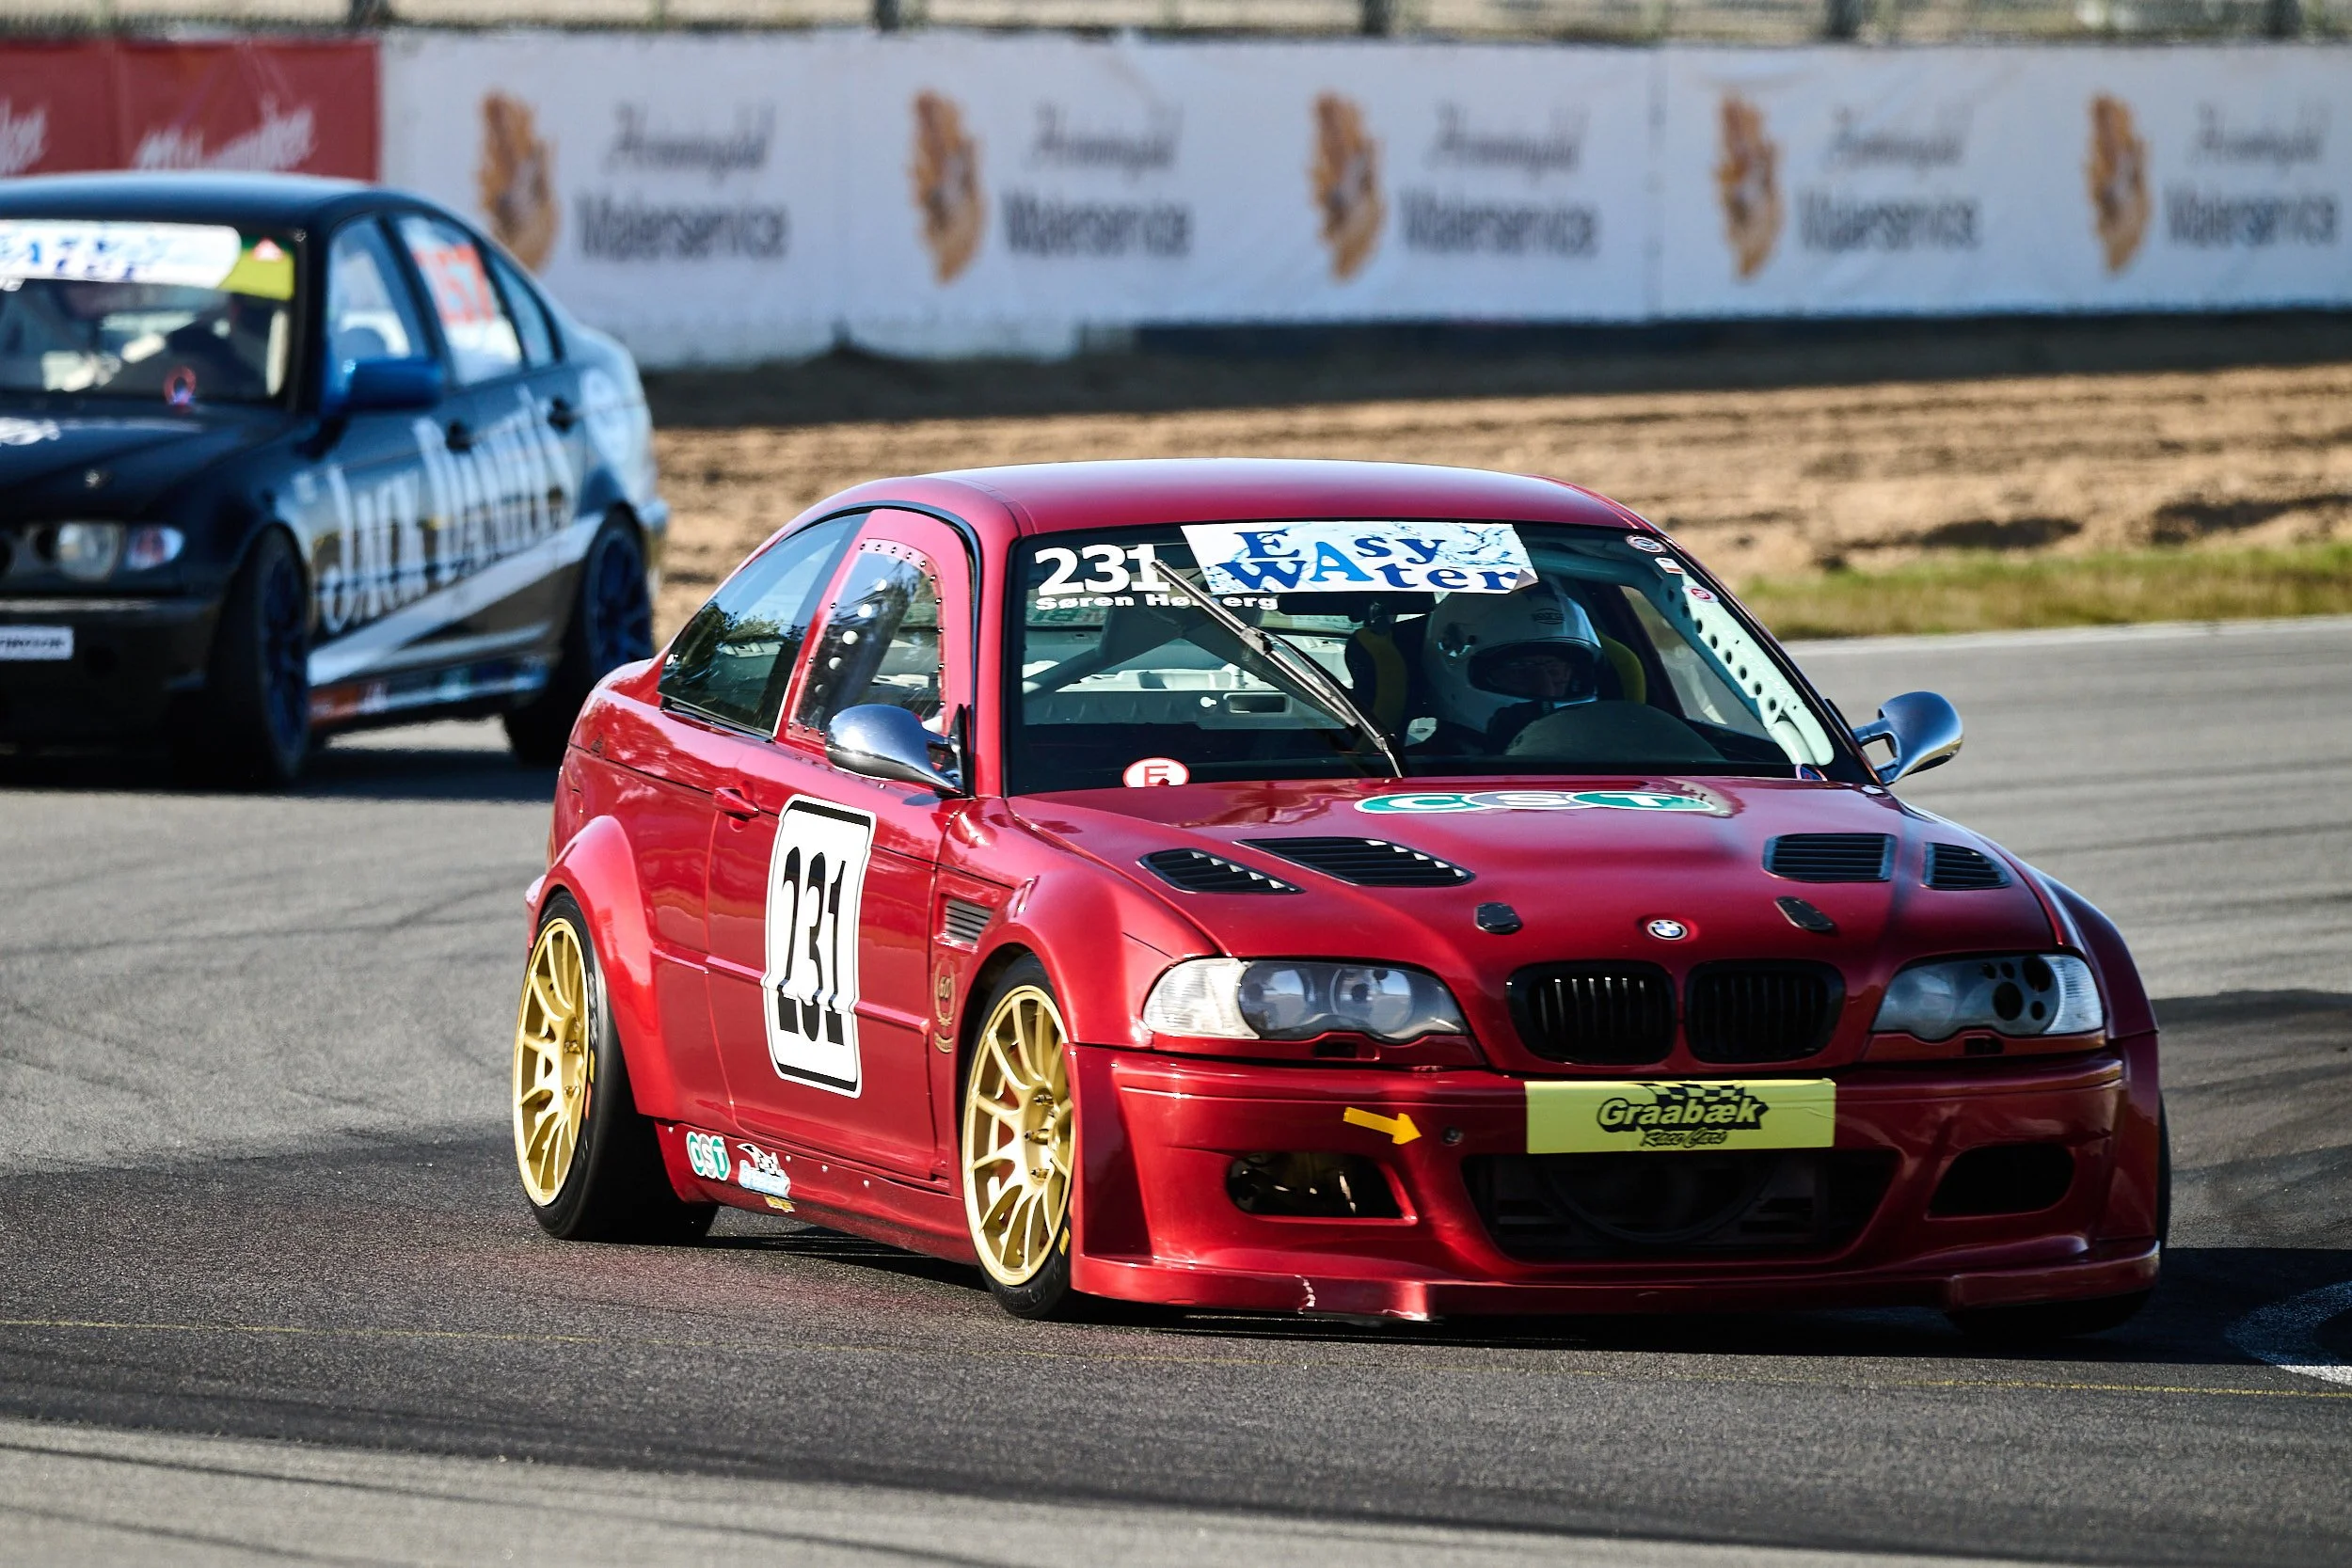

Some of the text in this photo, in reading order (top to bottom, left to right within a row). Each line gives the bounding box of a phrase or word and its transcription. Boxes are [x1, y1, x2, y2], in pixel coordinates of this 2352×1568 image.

[1035, 544, 1170, 595] 231
[1035, 594, 1279, 611] Søren Høerg
[1383, 792, 1670, 807] CST
[777, 847, 847, 1046] 231
[1598, 1097, 1765, 1130] Graabæk
[689, 1138, 728, 1174] CST
